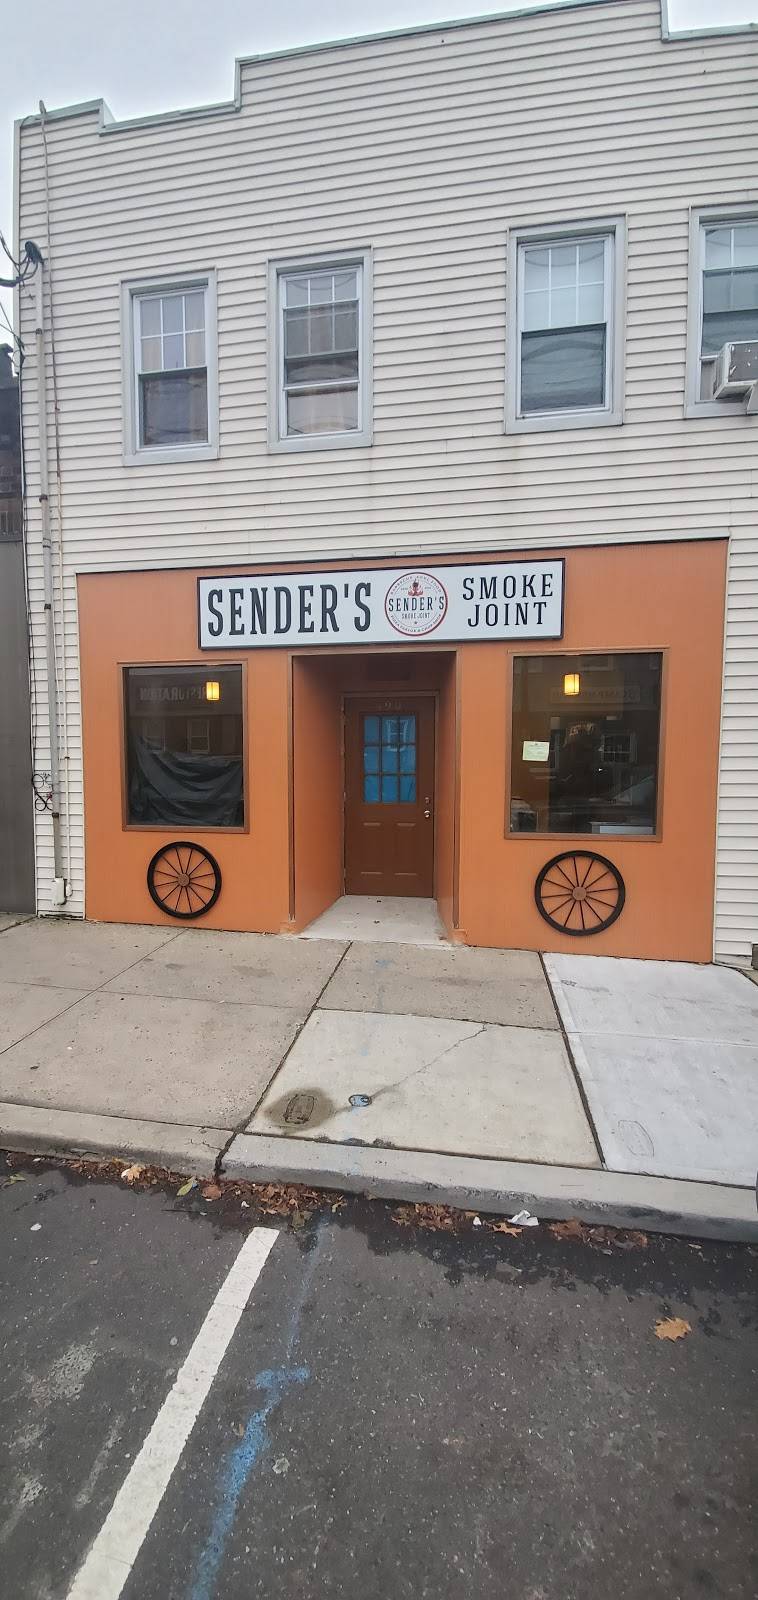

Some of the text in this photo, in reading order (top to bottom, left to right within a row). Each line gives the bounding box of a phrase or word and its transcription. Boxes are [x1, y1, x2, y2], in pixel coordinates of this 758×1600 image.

[462, 574, 554, 600] SMOKE
[207, 582, 371, 636] SENDER'S
[389, 596, 444, 612] SENDER'S
[467, 602, 547, 627] JOINT
